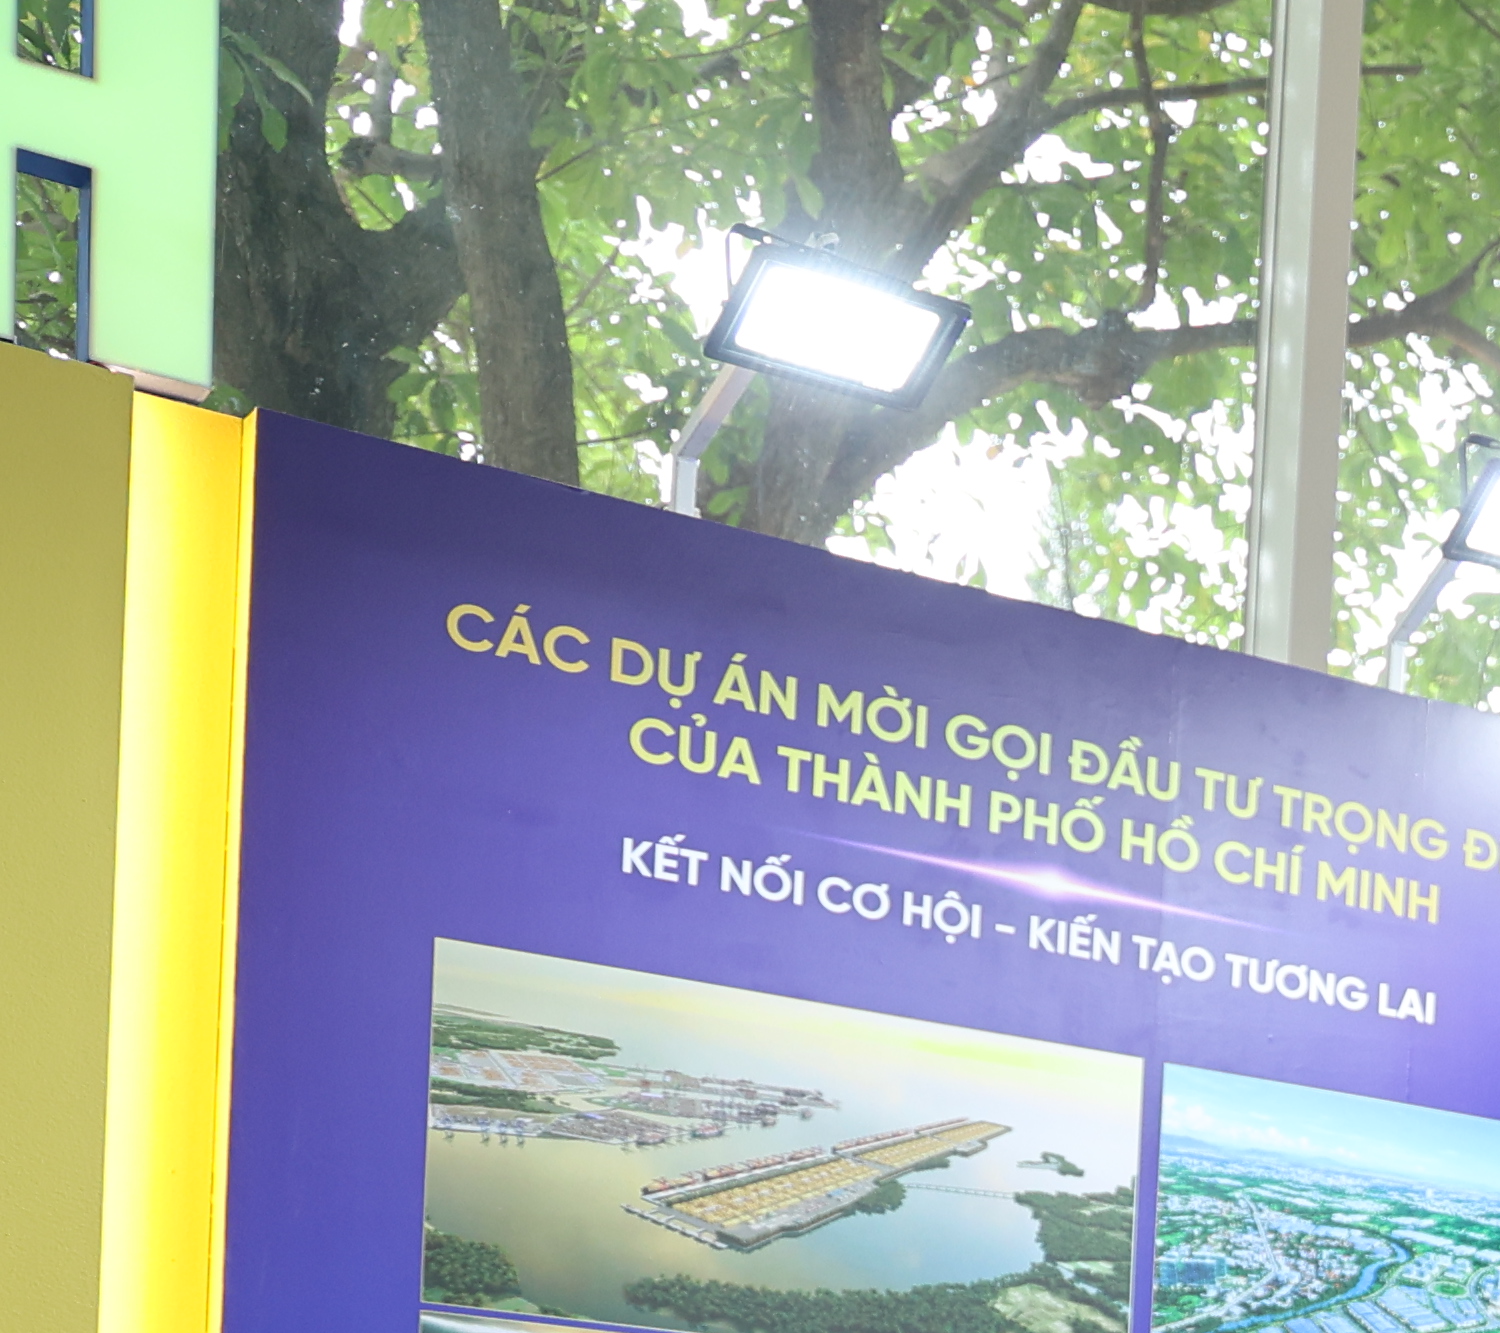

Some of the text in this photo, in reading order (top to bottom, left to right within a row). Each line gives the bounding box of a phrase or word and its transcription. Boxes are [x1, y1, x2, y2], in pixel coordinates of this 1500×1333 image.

[446, 604, 590, 673] CÁC
[610, 636, 702, 709] DỰ
[713, 652, 798, 720] ÁN
[816, 683, 929, 749] MỜI
[944, 712, 1052, 782] GỌI
[1068, 734, 1181, 803] ĐẦU
[1194, 766, 1264, 820] TƯ
[1273, 784, 1449, 861] TRỌNG
[629, 713, 1441, 925] CỦA THÀNH PHỐ HỒ CHÍ MINH
[621, 833, 1437, 1025] KẾT NỐI CƠ HỘI KIẾN TẠO TƯƠNG LAI
